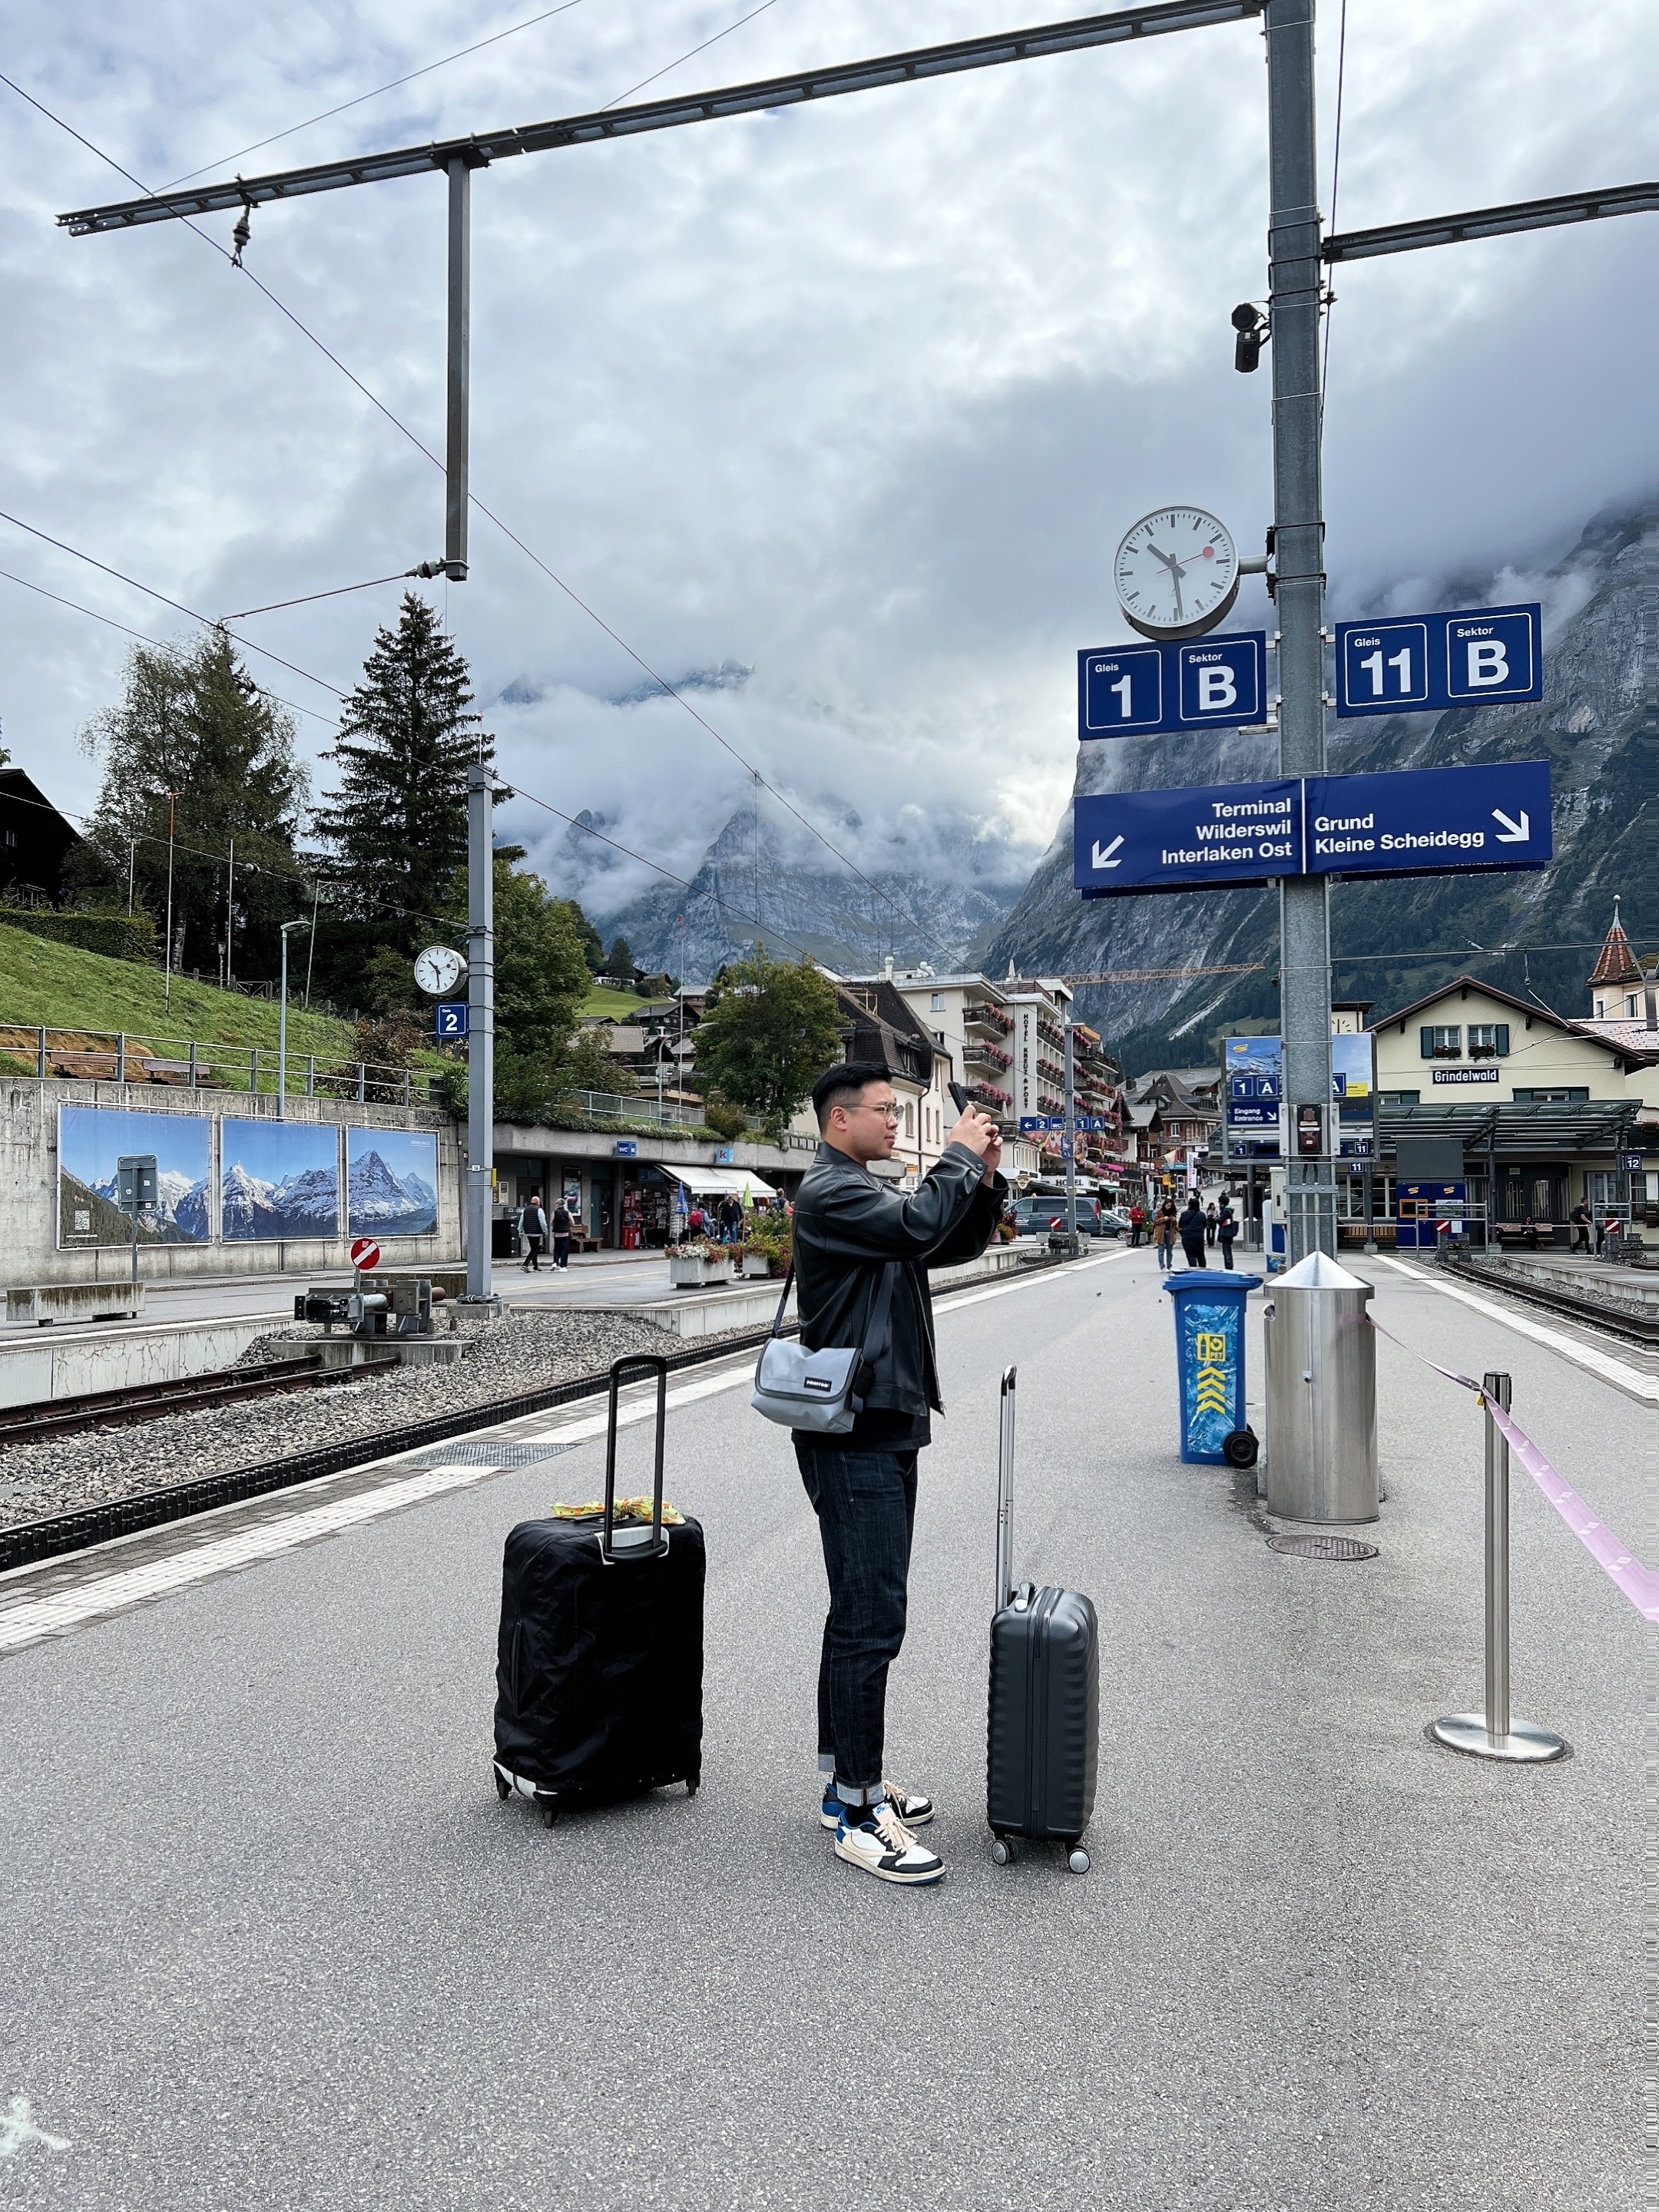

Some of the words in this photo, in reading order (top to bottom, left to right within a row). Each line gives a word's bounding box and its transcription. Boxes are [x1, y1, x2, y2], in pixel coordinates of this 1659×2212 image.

[1456, 627, 1494, 637] Sektor
[1354, 637, 1381, 647] Gleis
[1188, 653, 1223, 663] Sektor
[1467, 640, 1509, 687] B
[1094, 663, 1119, 673] Gleis
[1361, 647, 1412, 695] 11
[1199, 665, 1237, 710] B
[1111, 674, 1131, 717] 1
[1212, 797, 1291, 818] Terminal
[1196, 819, 1292, 840] Wilderswil
[1314, 813, 1374, 832] Grund
[1315, 836, 1376, 854] Kleine
[1380, 830, 1485, 850] Scheidegg
[1162, 845, 1253, 864] Interlaken
[1258, 842, 1293, 858] Ost
[445, 1013, 458, 1031] 2
[1435, 1070, 1497, 1082] Grindelwald
[1239, 1083, 1246, 1094] 1
[1261, 1082, 1273, 1094] A
[1234, 1108, 1260, 1116] Eingang
[1352, 1163, 1362, 1171] 11
[1627, 1159, 1640, 1168] 12
[1055, 1178, 1084, 1187] HOEL
